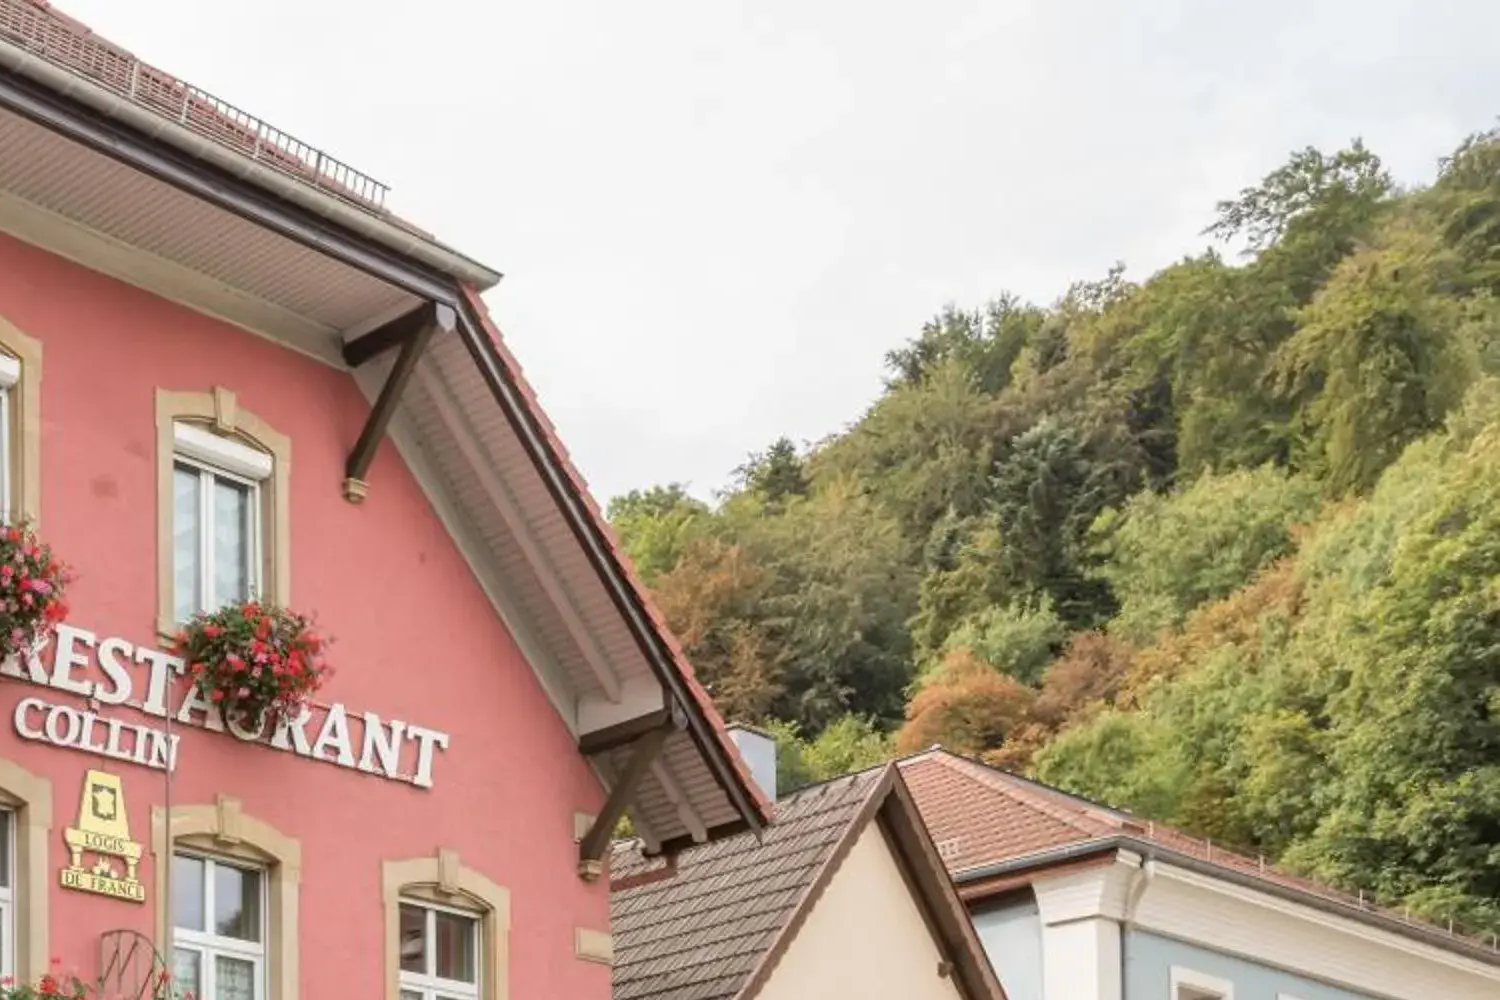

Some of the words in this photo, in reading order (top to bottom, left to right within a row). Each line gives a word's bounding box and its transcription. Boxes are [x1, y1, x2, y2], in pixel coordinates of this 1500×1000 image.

[14, 697, 181, 772] COLLIN
[84, 833, 125, 852] LOGIS
[65, 871, 83, 886] DE
[92, 877, 143, 899] FRANCE
